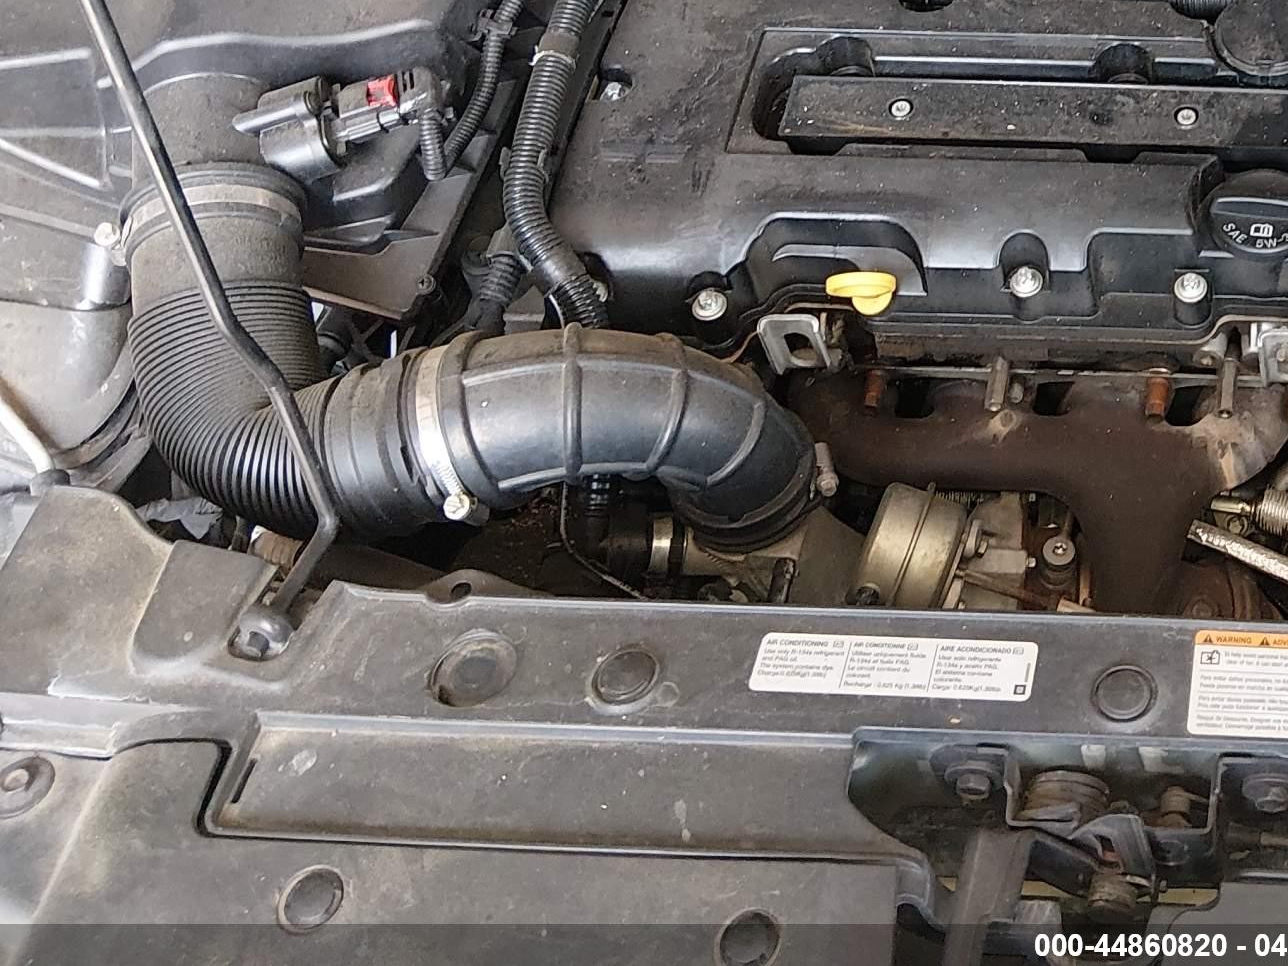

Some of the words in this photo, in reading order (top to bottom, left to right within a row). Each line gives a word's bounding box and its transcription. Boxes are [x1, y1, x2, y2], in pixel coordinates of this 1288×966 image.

[1222, 222, 1248, 244] SAE
[779, 639, 829, 647] CONDITIONING
[1216, 635, 1252, 644] WARNING
[956, 646, 1012, 654] ACONDICIONADO
